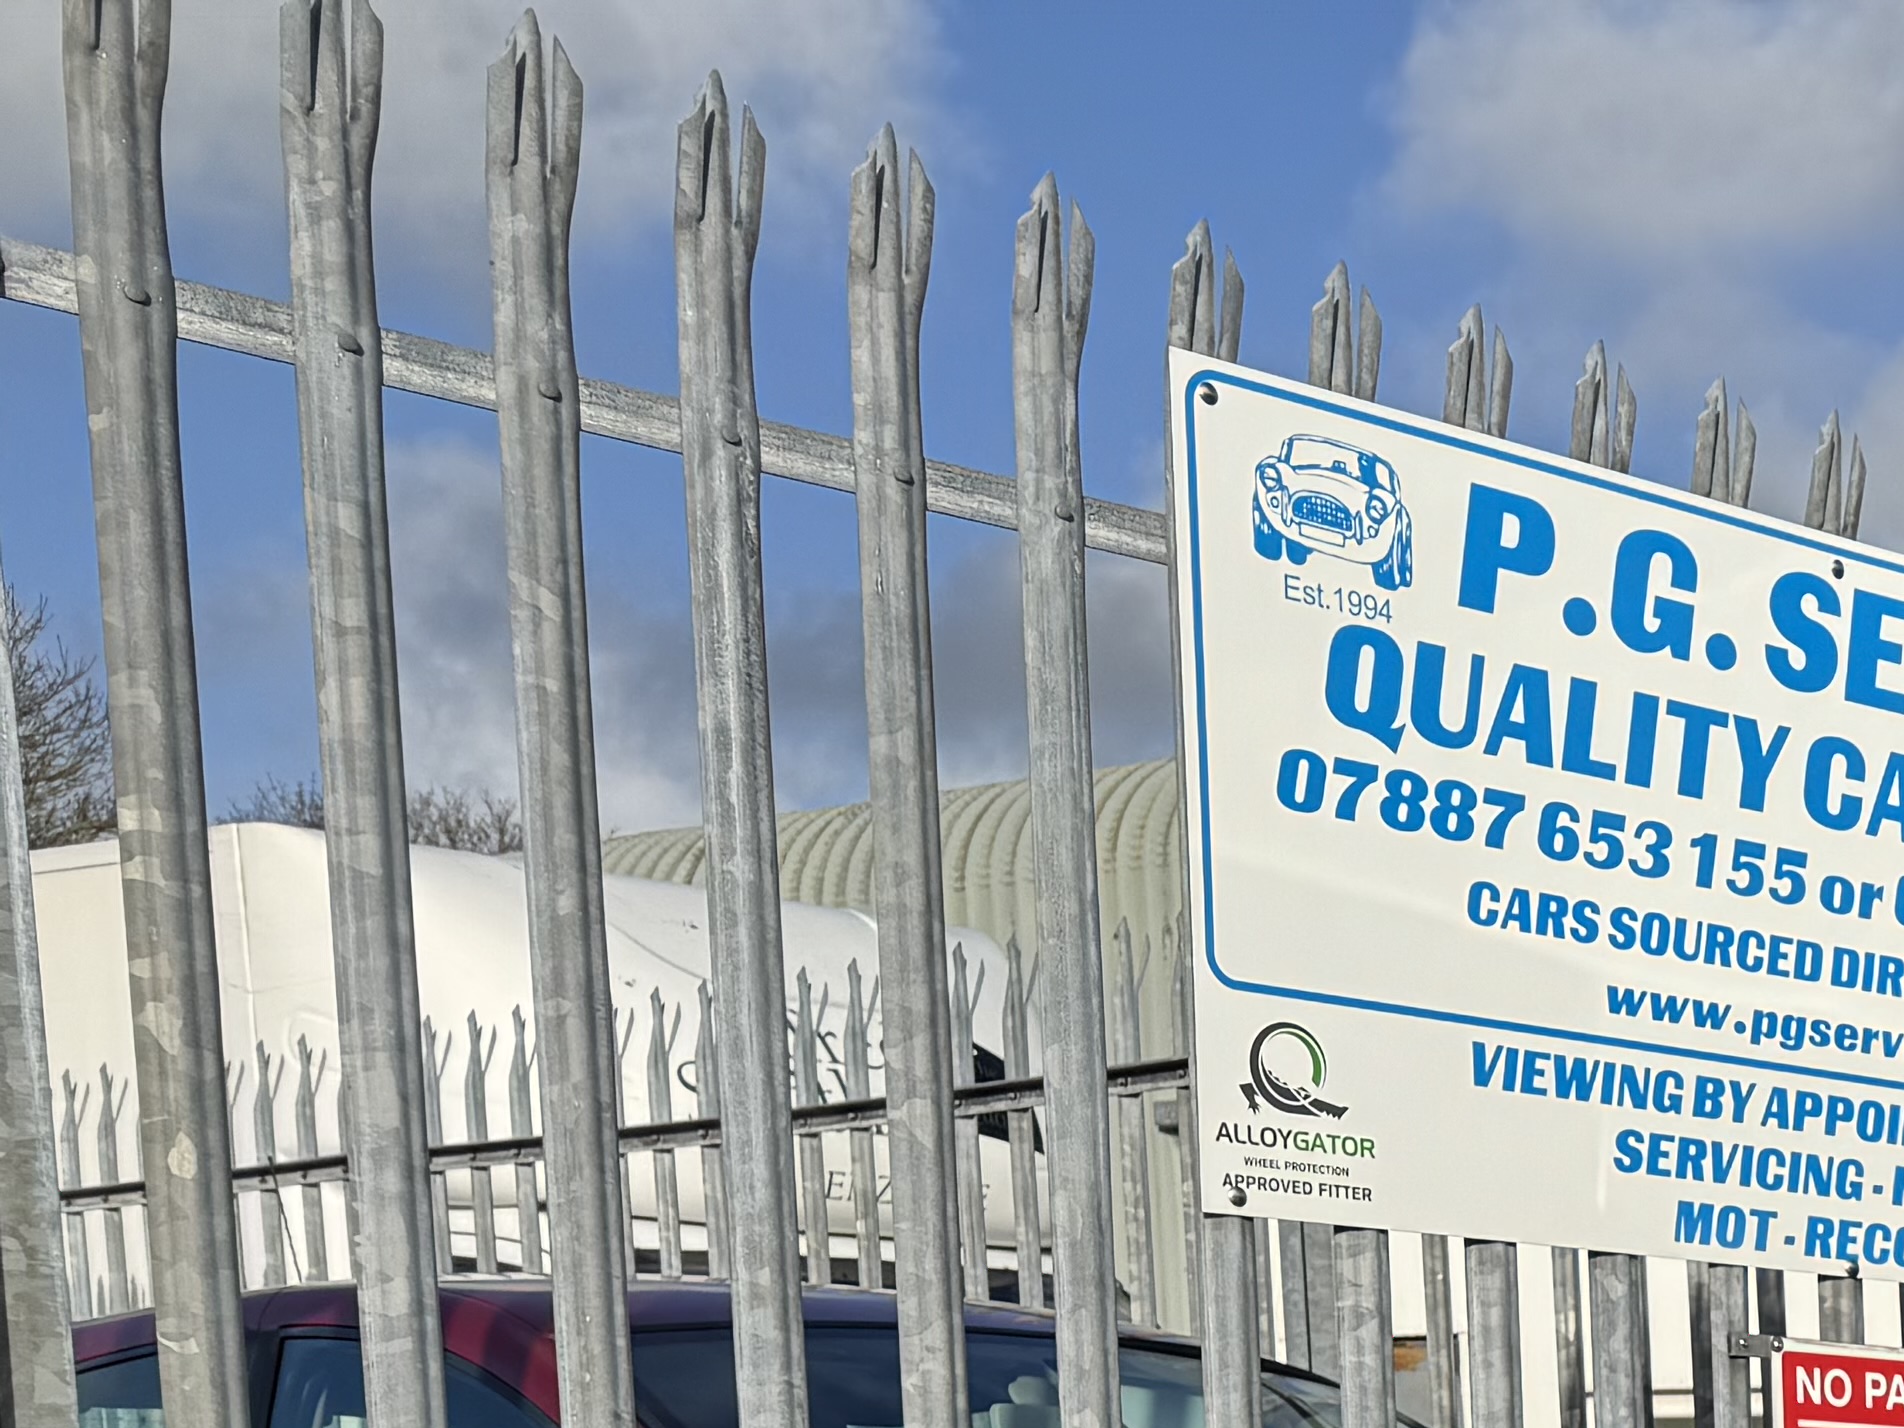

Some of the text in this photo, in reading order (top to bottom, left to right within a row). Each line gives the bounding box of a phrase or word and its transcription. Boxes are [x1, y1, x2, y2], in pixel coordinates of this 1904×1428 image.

[1283, 574, 1393, 625] Est.1994
[1458, 483, 1738, 672] P.G.
[1325, 624, 1791, 813] QUALITY
[1277, 749, 1526, 850] 07887
[1537, 801, 1674, 879] 653
[1691, 833, 1809, 906] 155
[1819, 875, 1885, 920] or
[1467, 881, 1601, 945] CARS
[1608, 907, 1824, 983] SOURCED
[1471, 1041, 1686, 1116] VIEWING
[1691, 1074, 1757, 1125] BY
[1215, 1121, 1376, 1159] ALLOYGATOR
[1244, 1156, 1350, 1178] WHEEL PROTECTION
[1613, 1128, 1866, 1202] SERVICING
[1222, 1172, 1372, 1202] APPROVED FITTER
[1674, 1200, 1778, 1253] MOT
[1795, 1365, 1852, 1408] NO
